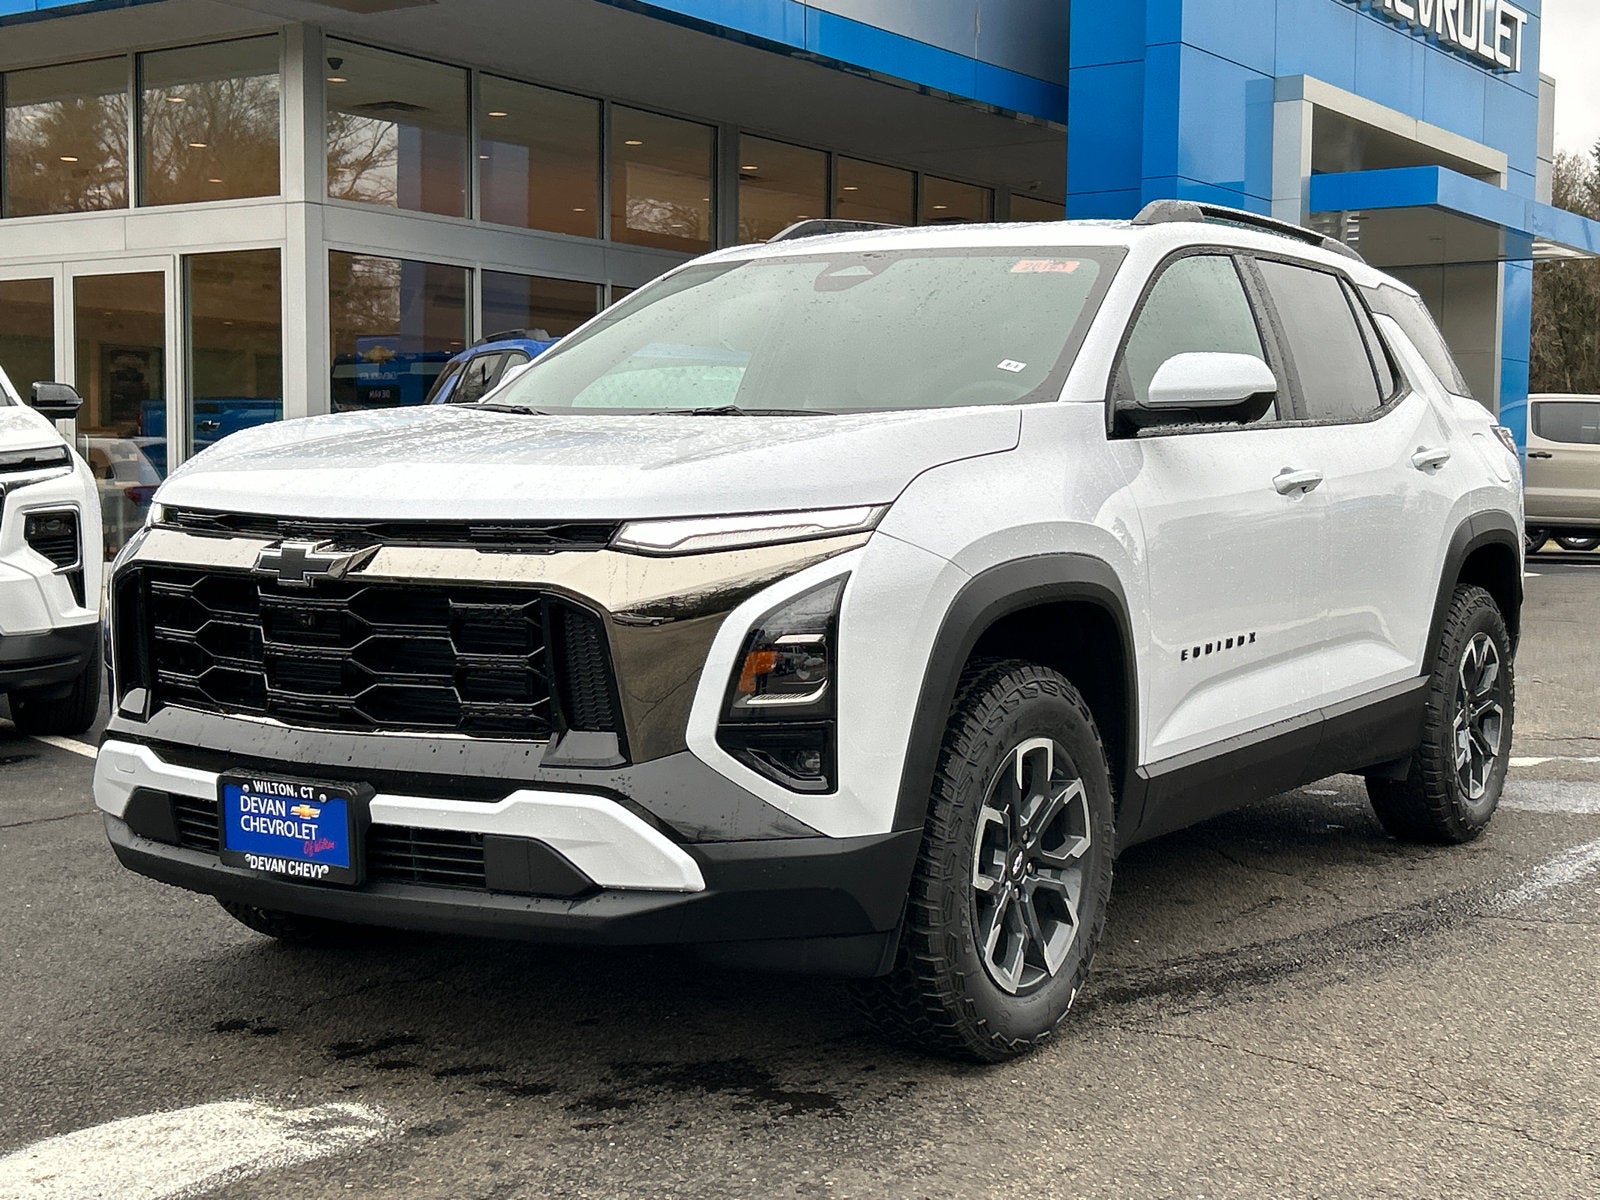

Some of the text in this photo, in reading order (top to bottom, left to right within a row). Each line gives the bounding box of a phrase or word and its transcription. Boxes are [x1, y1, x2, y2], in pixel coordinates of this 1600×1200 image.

[1181, 632, 1256, 661] EQUINOX
[252, 780, 314, 799] WILTON, CT
[240, 795, 286, 817] DEVAN
[240, 815, 318, 840] CHEVROLET
[250, 855, 323, 878] DEVAN CHEVY
